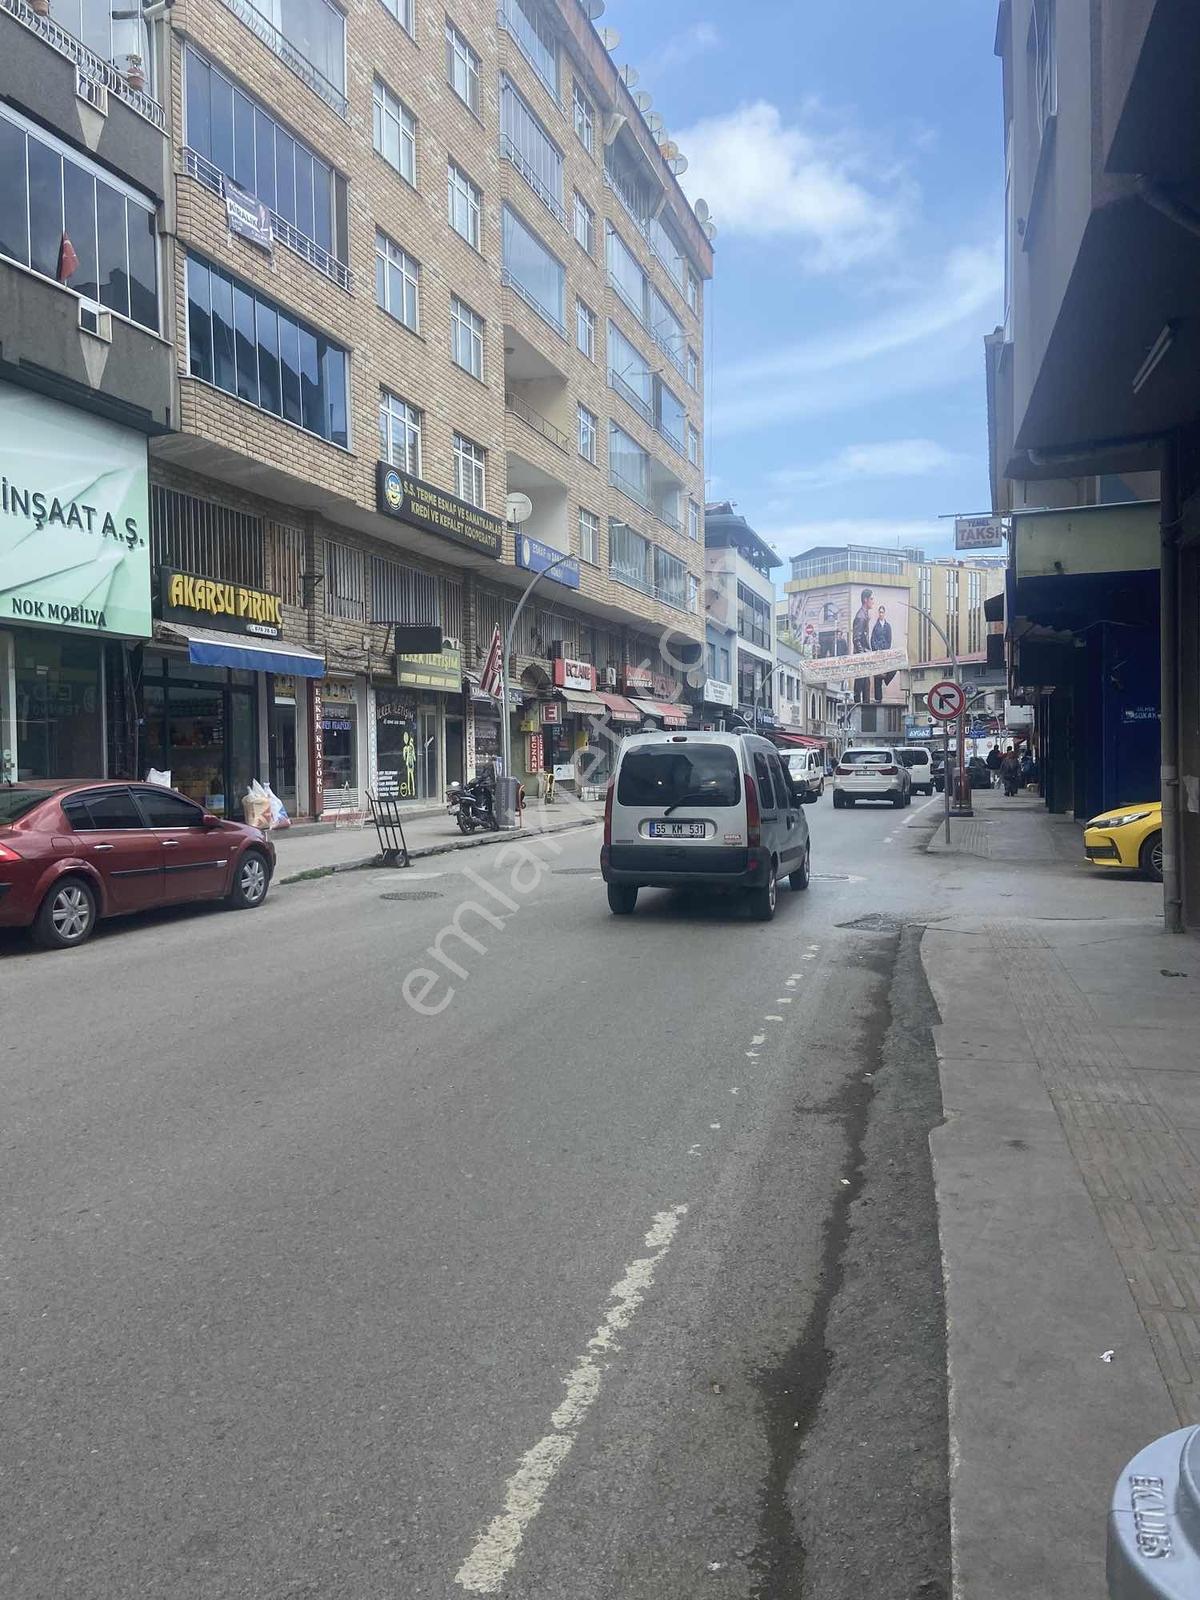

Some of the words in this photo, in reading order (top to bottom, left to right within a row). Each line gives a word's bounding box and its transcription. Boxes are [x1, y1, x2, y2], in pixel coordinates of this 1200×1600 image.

[1, 477, 97, 530] İNŞAAT
[102, 511, 145, 550] A.Ş.
[417, 486, 438, 507] TERME
[438, 498, 457, 517] ESNAF
[457, 508, 466, 520] VE
[431, 509, 440, 523] VE
[12, 598, 45, 618] NOK
[48, 603, 107, 627] MOBİLYA
[169, 574, 236, 615] AKARSU
[237, 587, 282, 629] PİRİNÇ
[656, 825, 666, 835] 55
[672, 825, 683, 835] KM
[689, 824, 703, 835] 531
